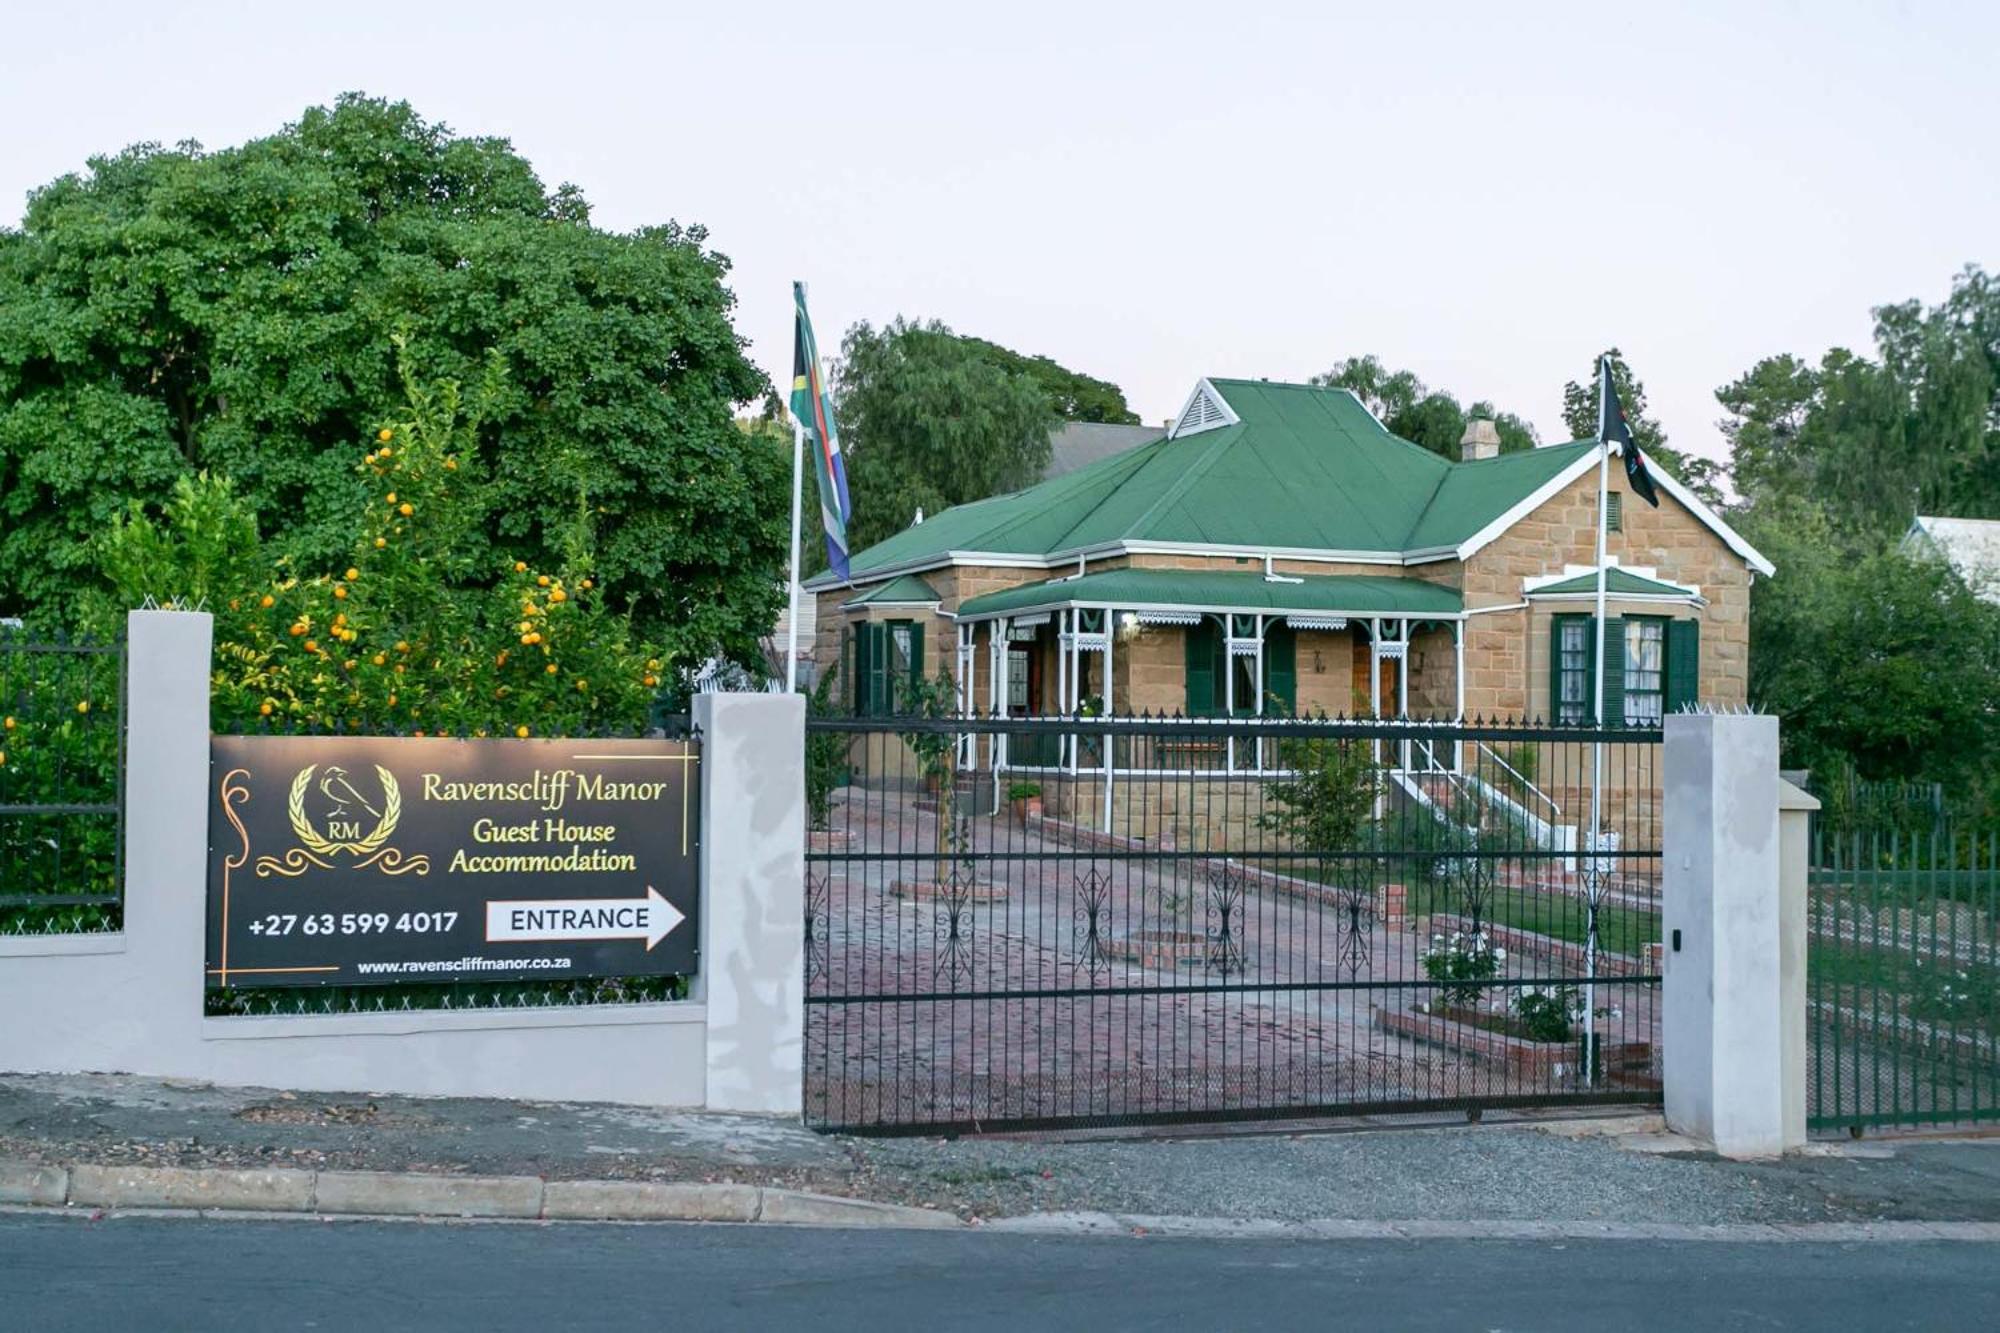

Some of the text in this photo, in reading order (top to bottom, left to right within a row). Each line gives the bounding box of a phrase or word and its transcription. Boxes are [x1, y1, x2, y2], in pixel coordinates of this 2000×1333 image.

[422, 769, 667, 810] Ravenscliff Manor
[328, 822, 360, 839] RM
[473, 818, 616, 842] Guest House
[449, 845, 637, 872] Accommodation
[249, 912, 458, 935] +27 63 599 4017
[511, 908, 649, 930] ENTRANCE
[358, 956, 572, 973] www.ravenscliffmanor.co.za
